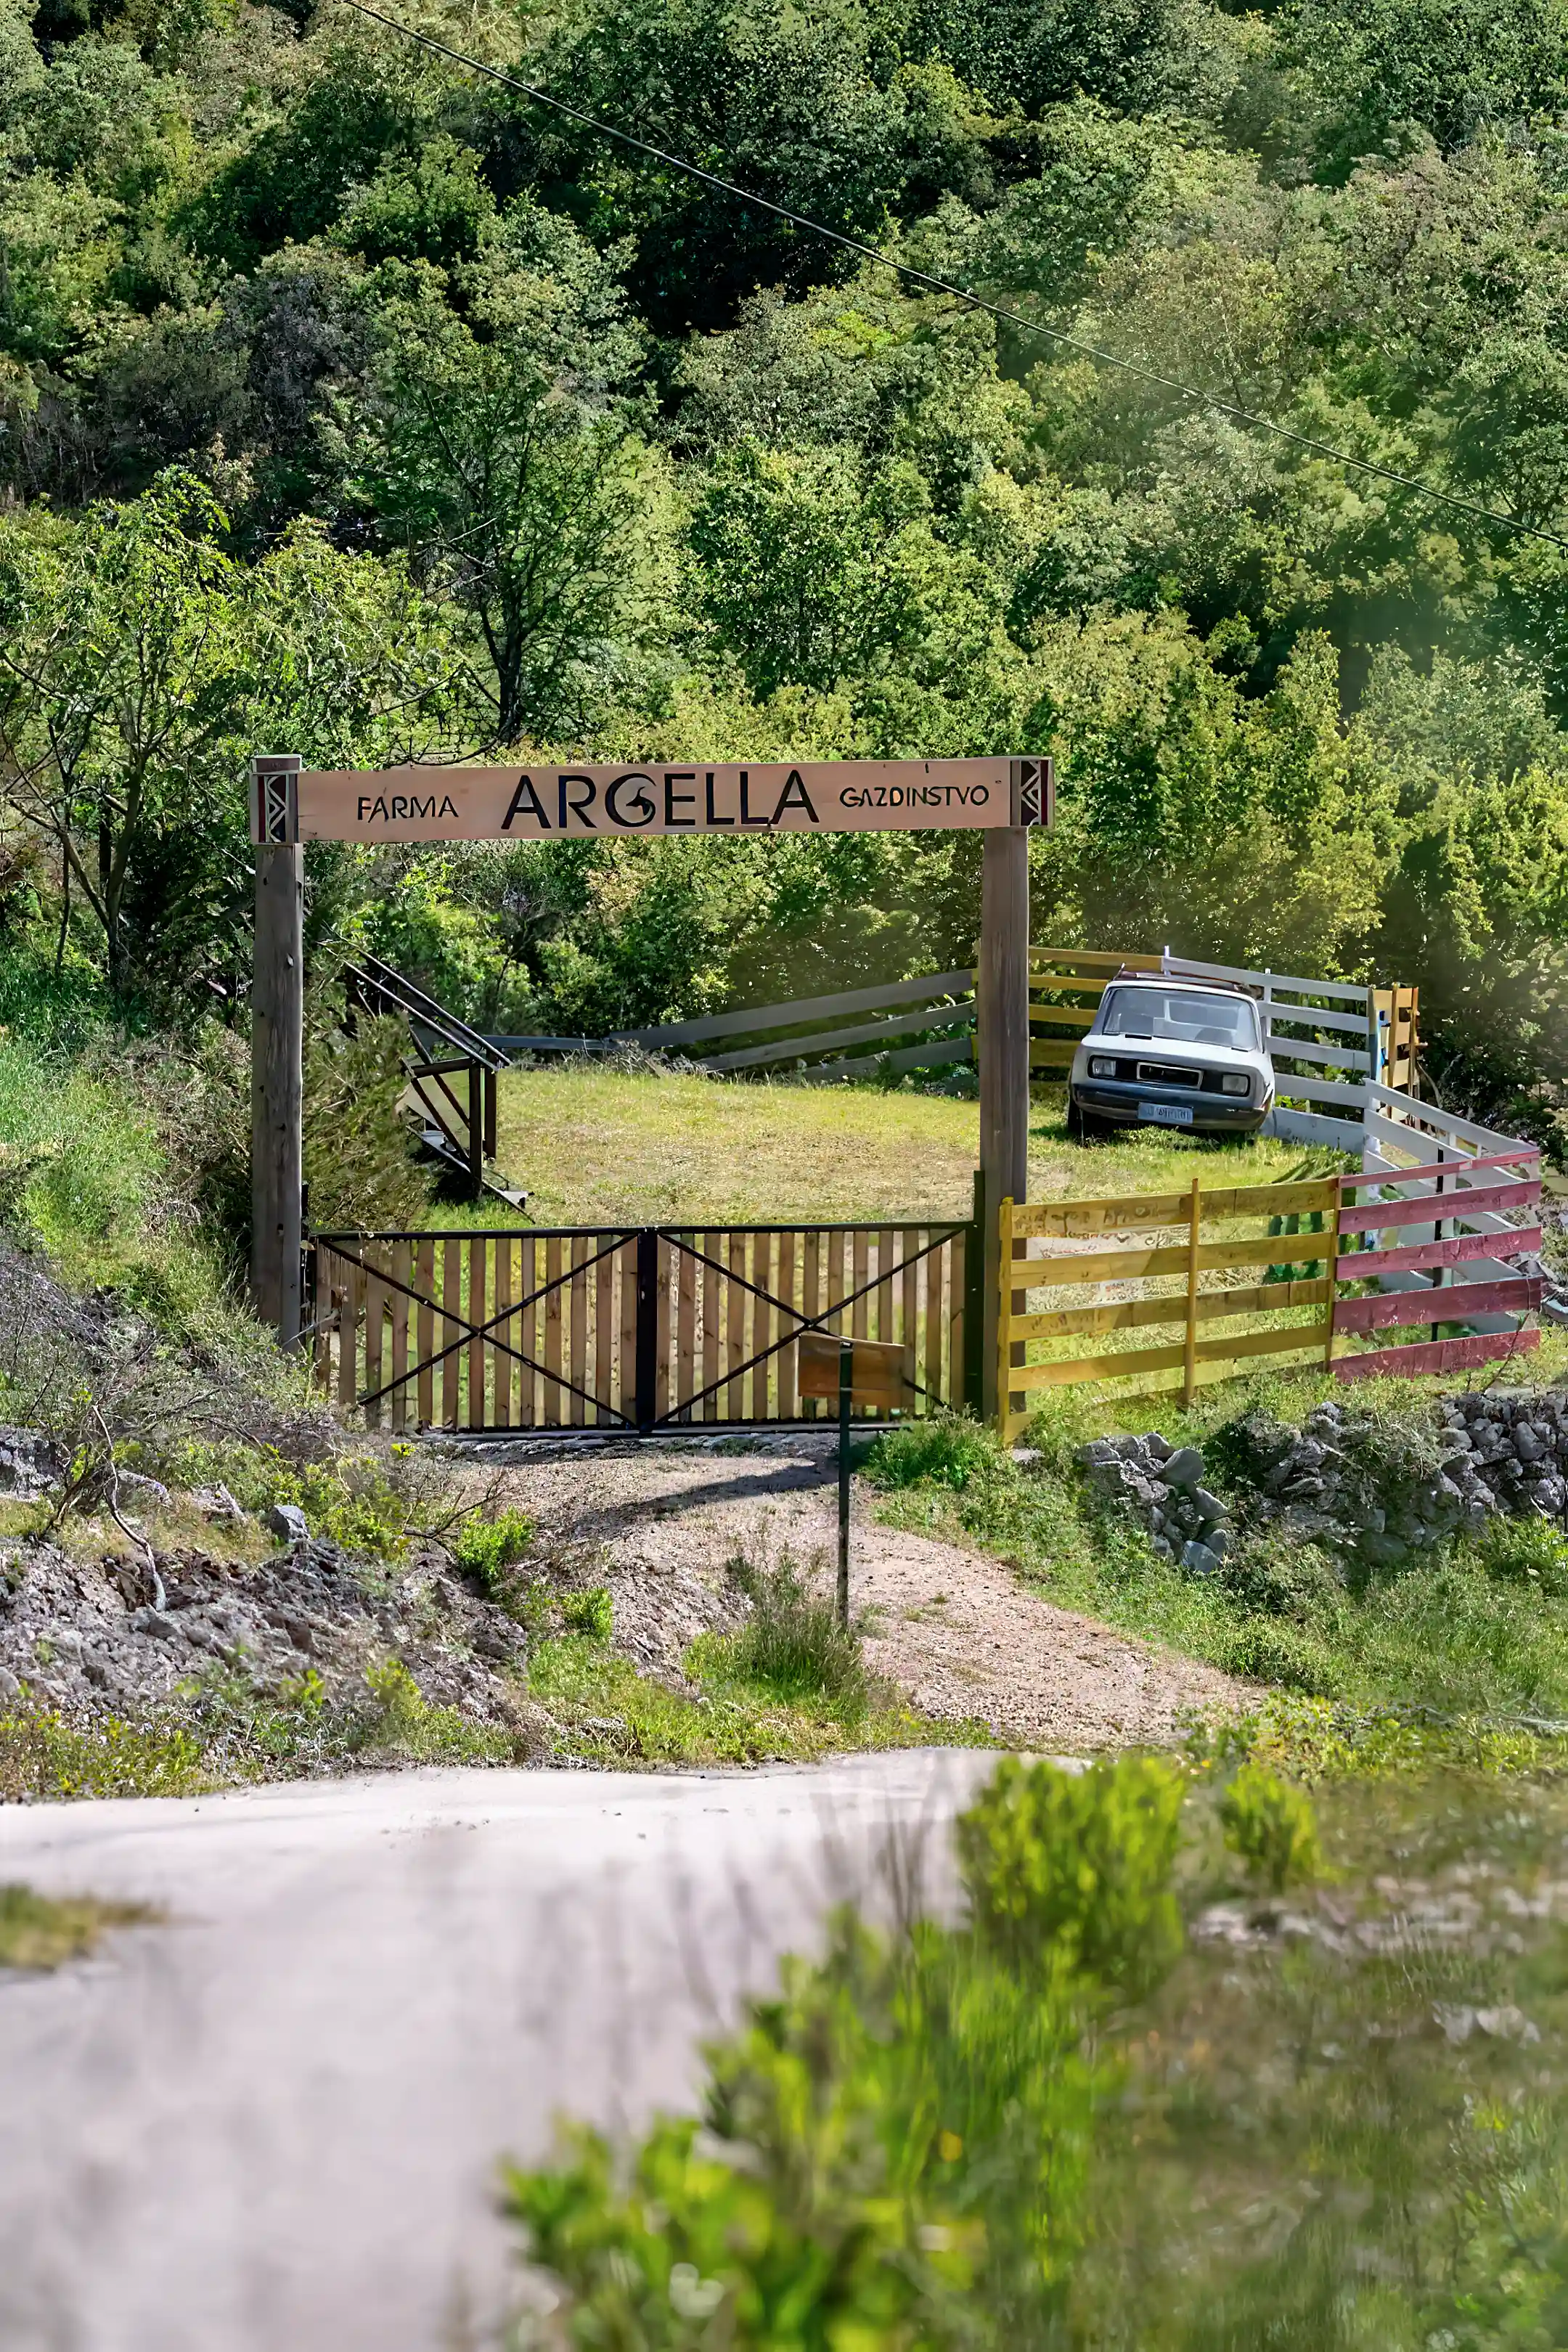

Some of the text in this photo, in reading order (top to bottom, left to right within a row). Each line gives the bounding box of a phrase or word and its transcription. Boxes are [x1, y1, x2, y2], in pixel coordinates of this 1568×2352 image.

[357, 769, 989, 830] FARMA ARGELLA GAZDINSTVO
